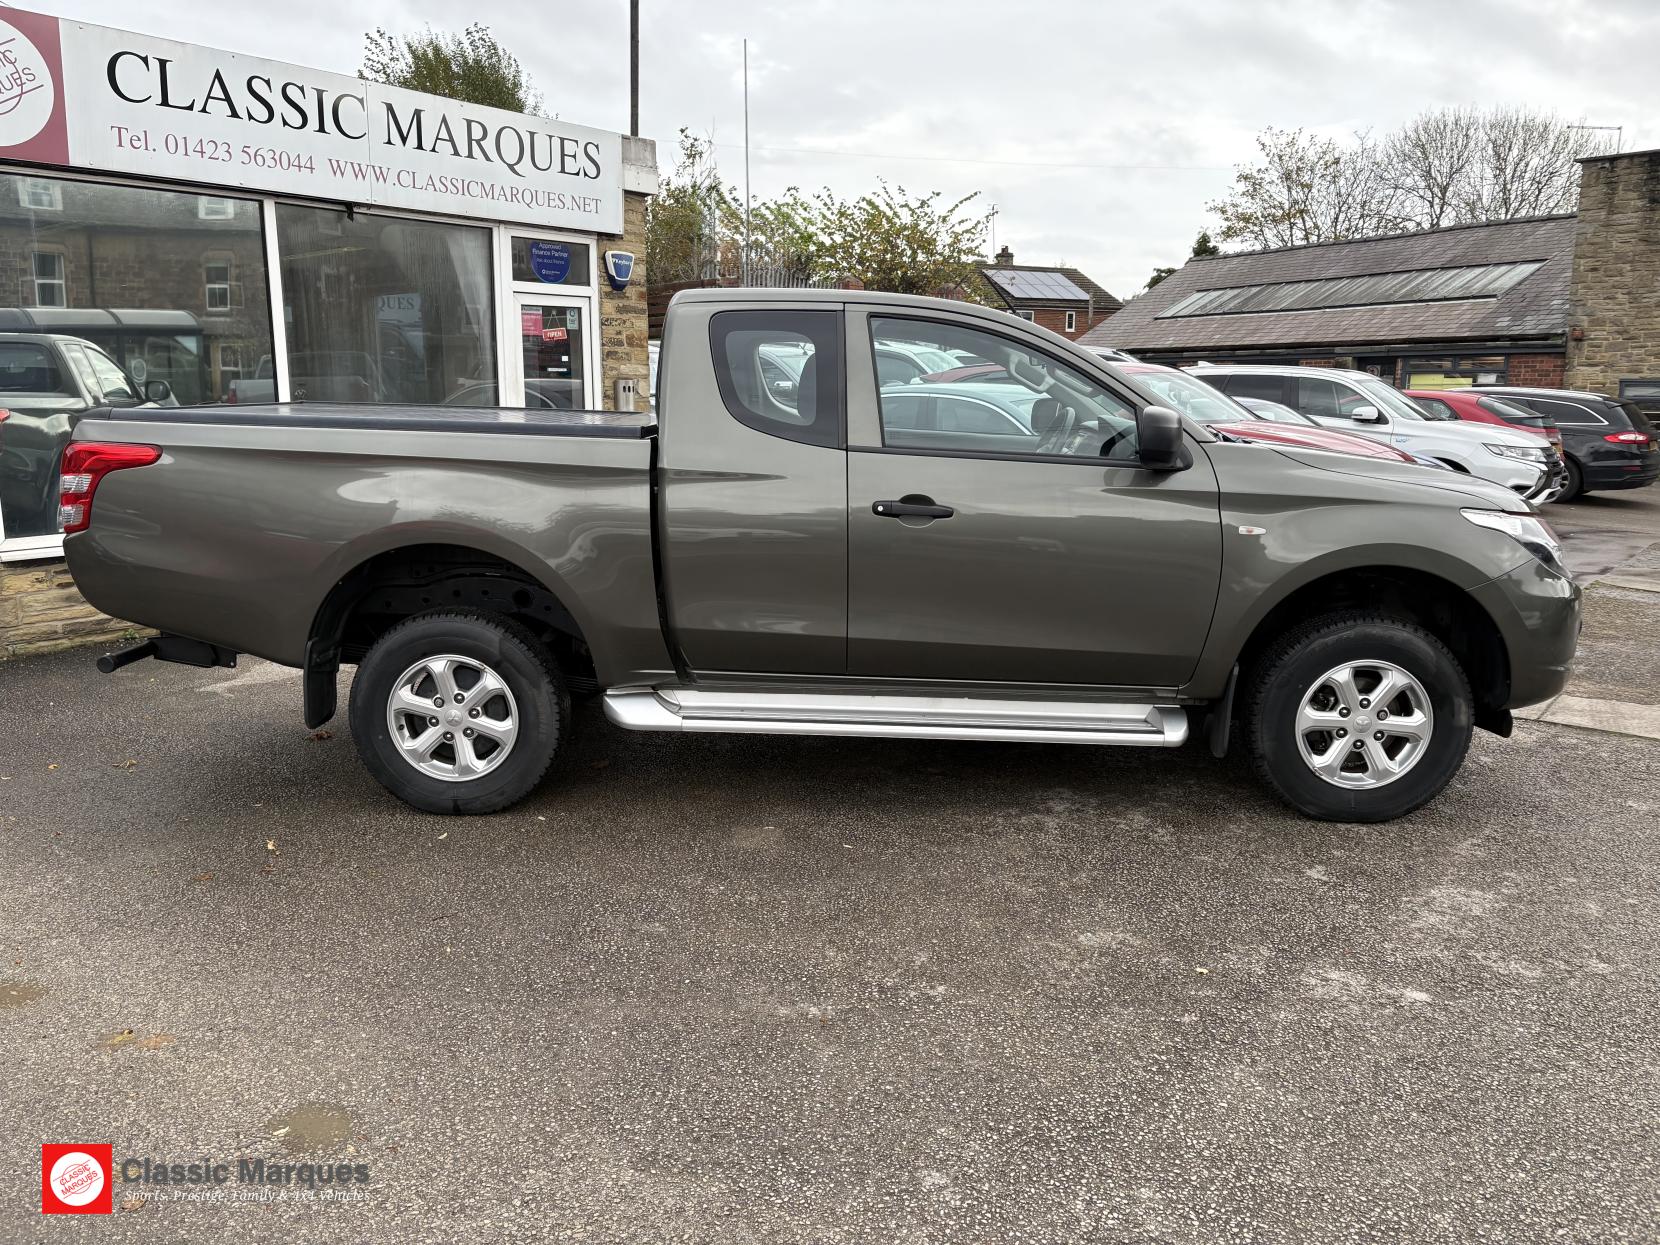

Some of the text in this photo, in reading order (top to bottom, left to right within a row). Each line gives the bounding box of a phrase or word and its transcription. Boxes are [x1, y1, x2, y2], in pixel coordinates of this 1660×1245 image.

[106, 50, 601, 179] CLASSIC MARQUES
[110, 125, 602, 215] Tel. 01423 563044 WWW.CLASSICMARQUES.NET
[551, 250, 568, 258] Partner
